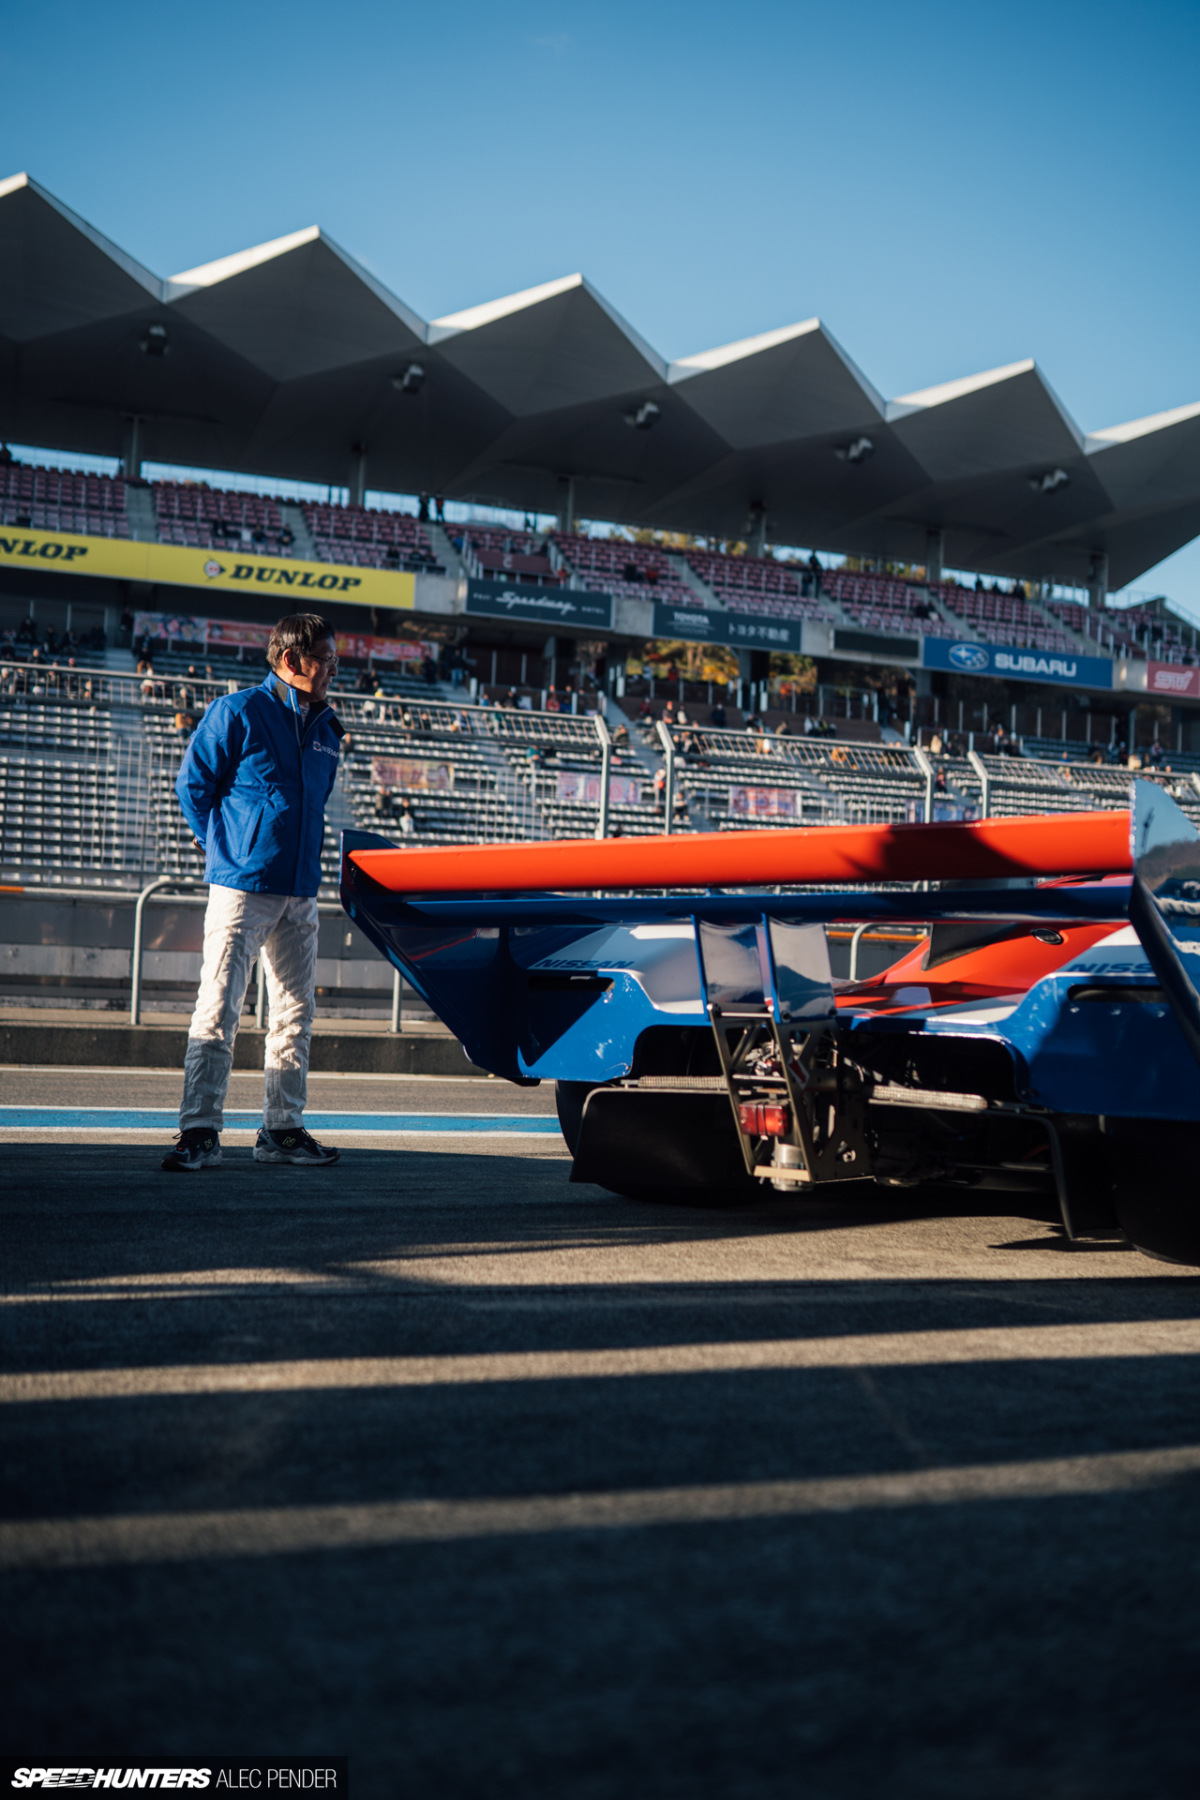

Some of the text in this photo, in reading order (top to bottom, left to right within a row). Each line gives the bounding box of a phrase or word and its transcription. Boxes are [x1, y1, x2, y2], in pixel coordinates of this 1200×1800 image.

[0, 536, 88, 561] NLOP
[229, 564, 362, 592] DUNLOP
[495, 591, 577, 616] Speedway
[673, 611, 710, 625] TOYOTA
[994, 652, 1078, 677] SUBARU
[534, 958, 635, 969] NISSAN
[1067, 962, 1154, 973] NISS
